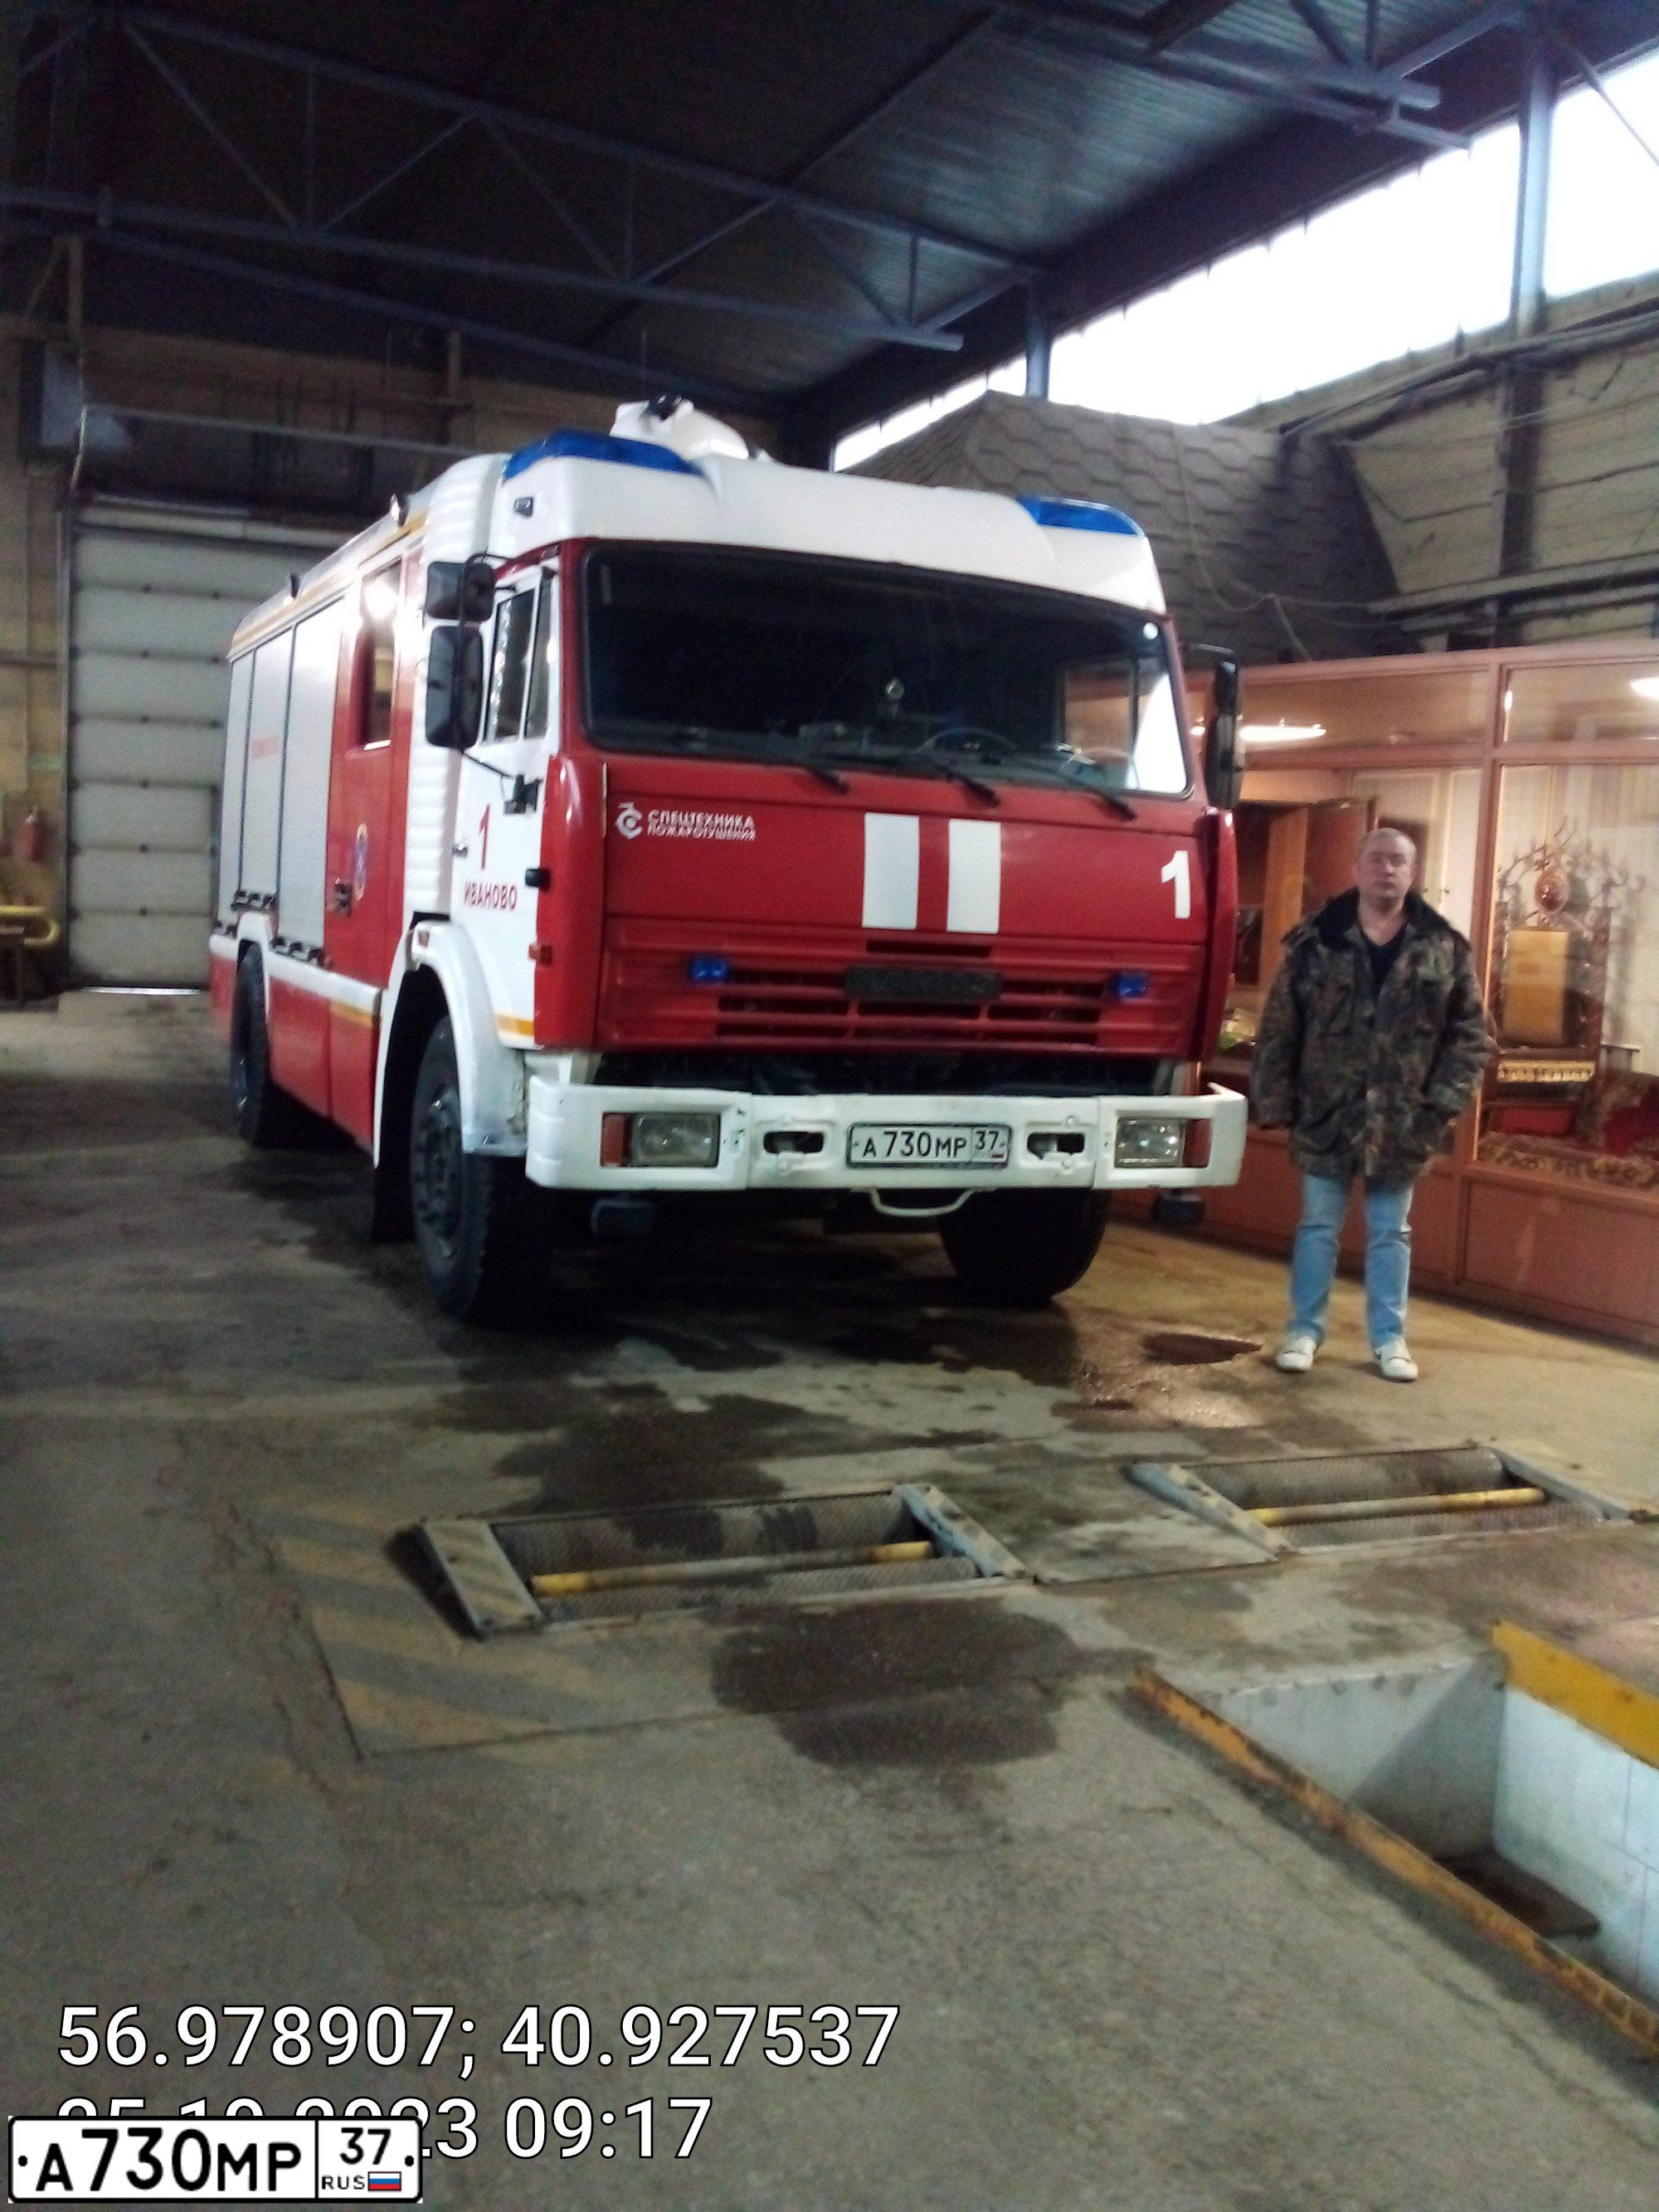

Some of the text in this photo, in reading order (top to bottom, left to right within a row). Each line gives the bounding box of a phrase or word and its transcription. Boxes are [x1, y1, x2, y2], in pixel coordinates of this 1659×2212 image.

[647, 809, 756, 830] СПЕЦТЕХНИКА
[465, 880, 518, 911] ИВАНОВО
[1160, 850, 1191, 919] 1
[863, 1130, 1000, 1158] А730МР 37
